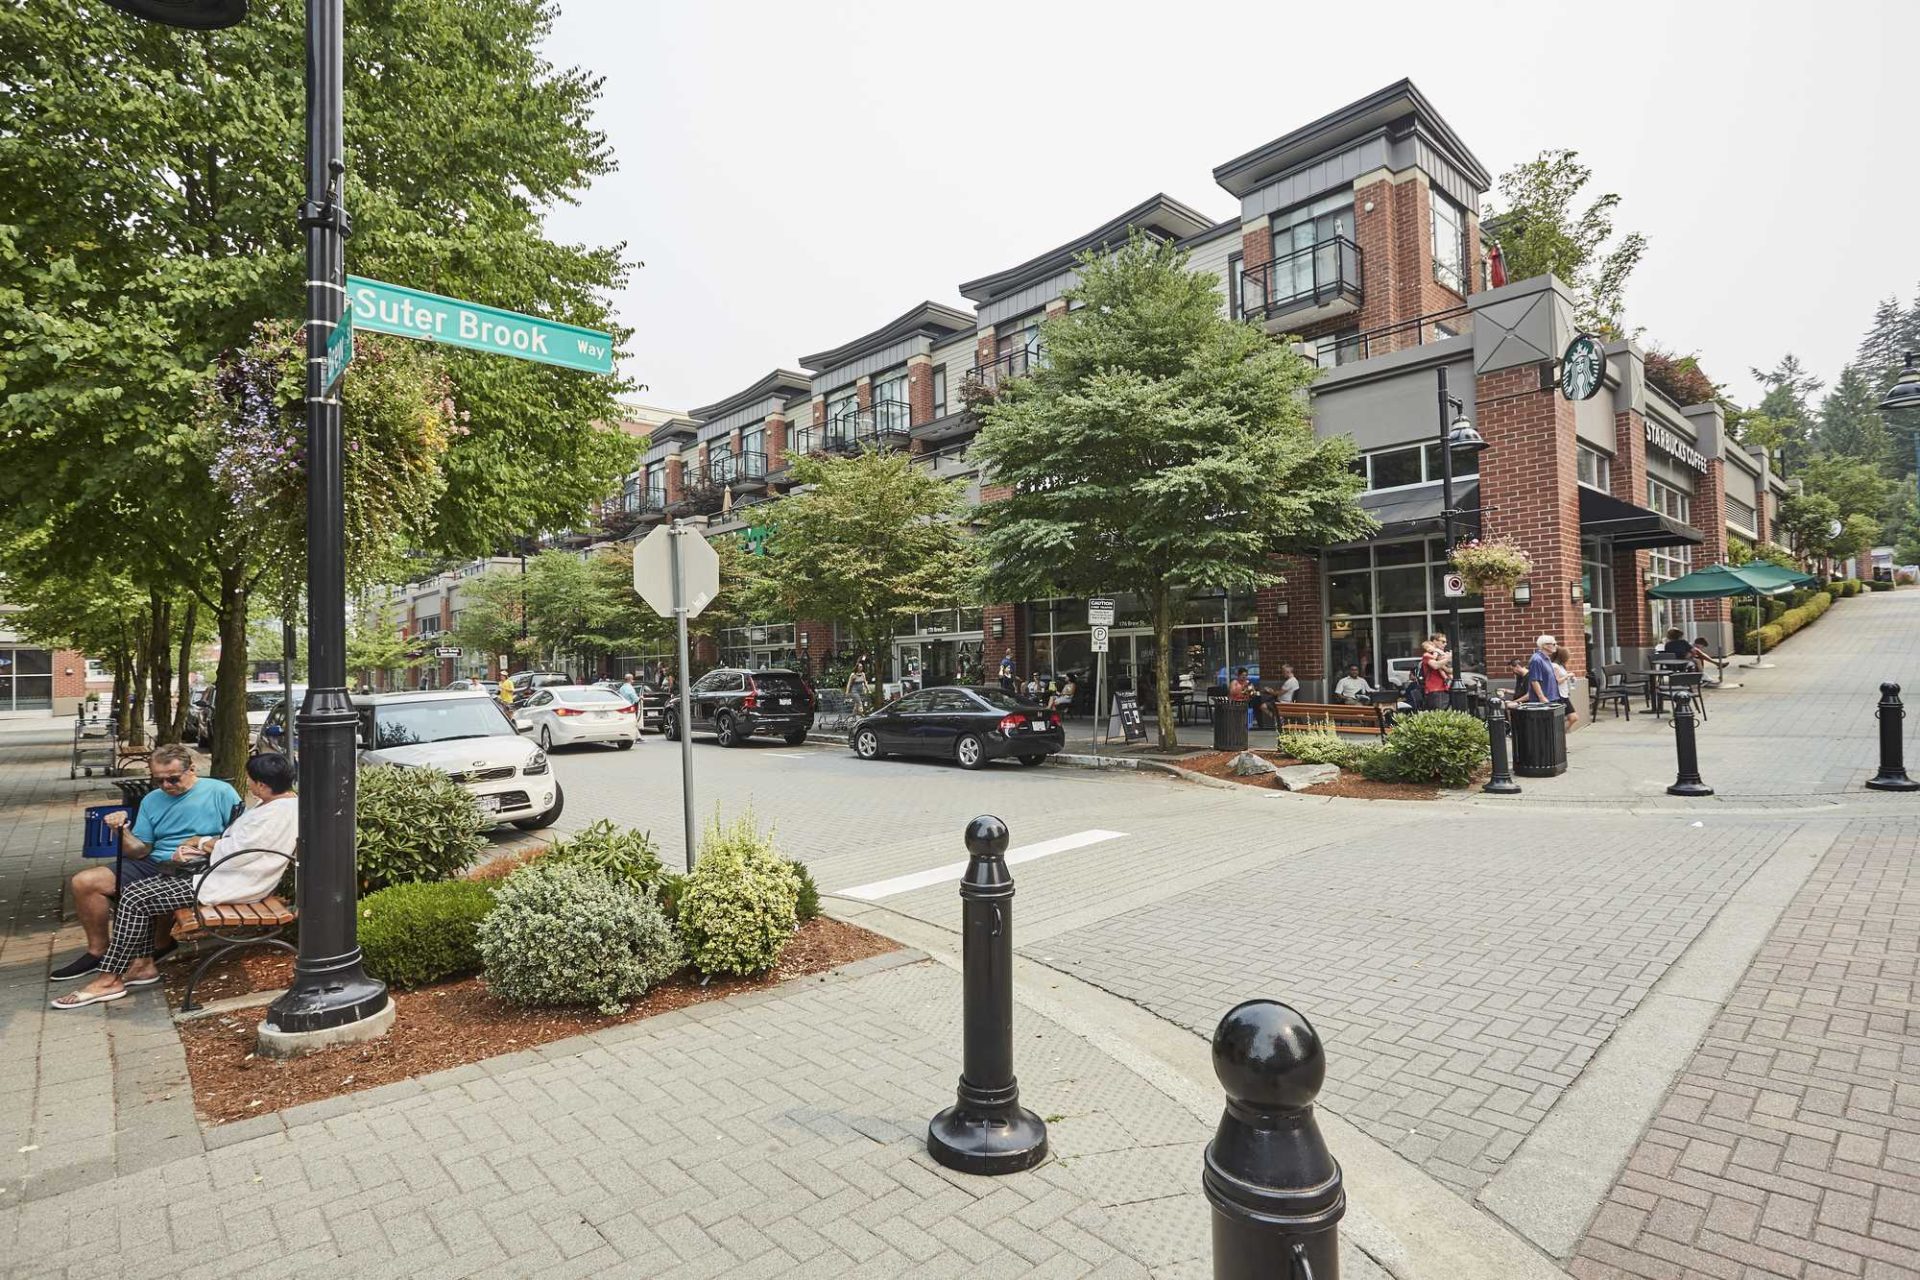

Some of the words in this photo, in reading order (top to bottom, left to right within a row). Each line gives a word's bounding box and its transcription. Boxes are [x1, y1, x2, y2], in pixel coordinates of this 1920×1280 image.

[355, 288, 448, 333] Suter
[459, 309, 548, 355] Brook
[577, 339, 605, 361] Way
[1646, 420, 1686, 463] STARBUCKS
[1686, 445, 1708, 474] COFFEE
